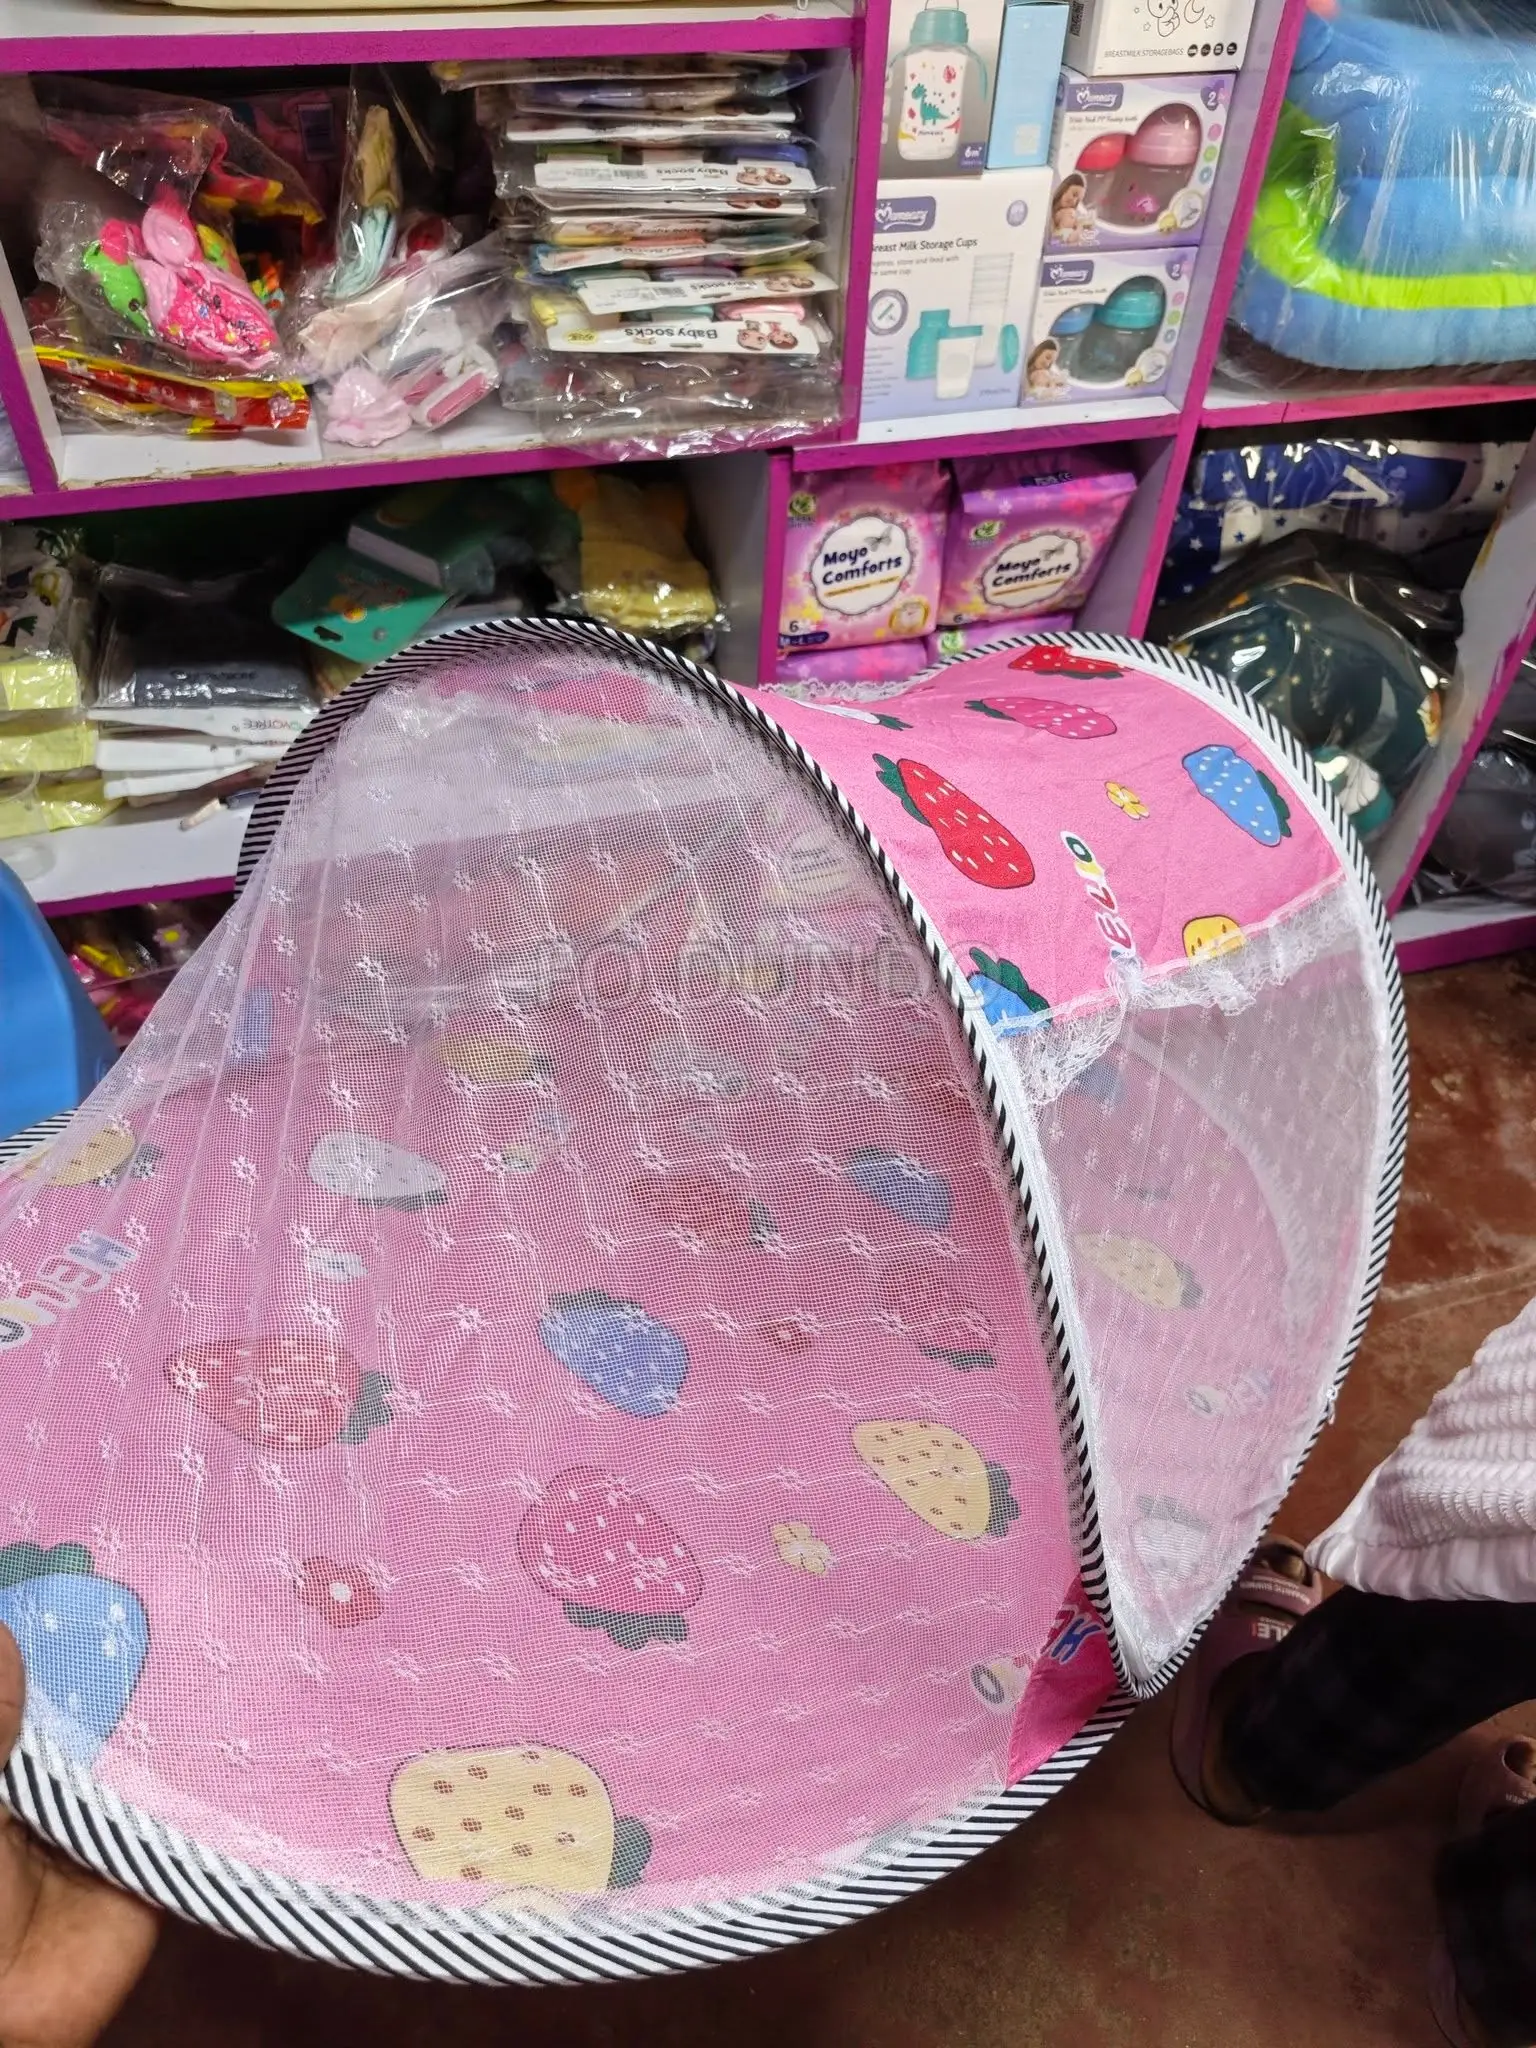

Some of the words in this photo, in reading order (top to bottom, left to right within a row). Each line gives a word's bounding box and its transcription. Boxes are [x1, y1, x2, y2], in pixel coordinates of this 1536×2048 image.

[898, 240, 918, 252] Milk
[919, 239, 955, 252] Storage
[955, 237, 979, 250] Cups
[624, 327, 675, 338] socks
[677, 327, 719, 339] Baby
[822, 546, 868, 567] Moyo
[821, 556, 903, 586] Comforts
[995, 558, 1042, 574] Moyo
[991, 562, 1072, 588] Comforts
[789, 620, 800, 633] 6
[1065, 833, 1134, 958] ELLO
